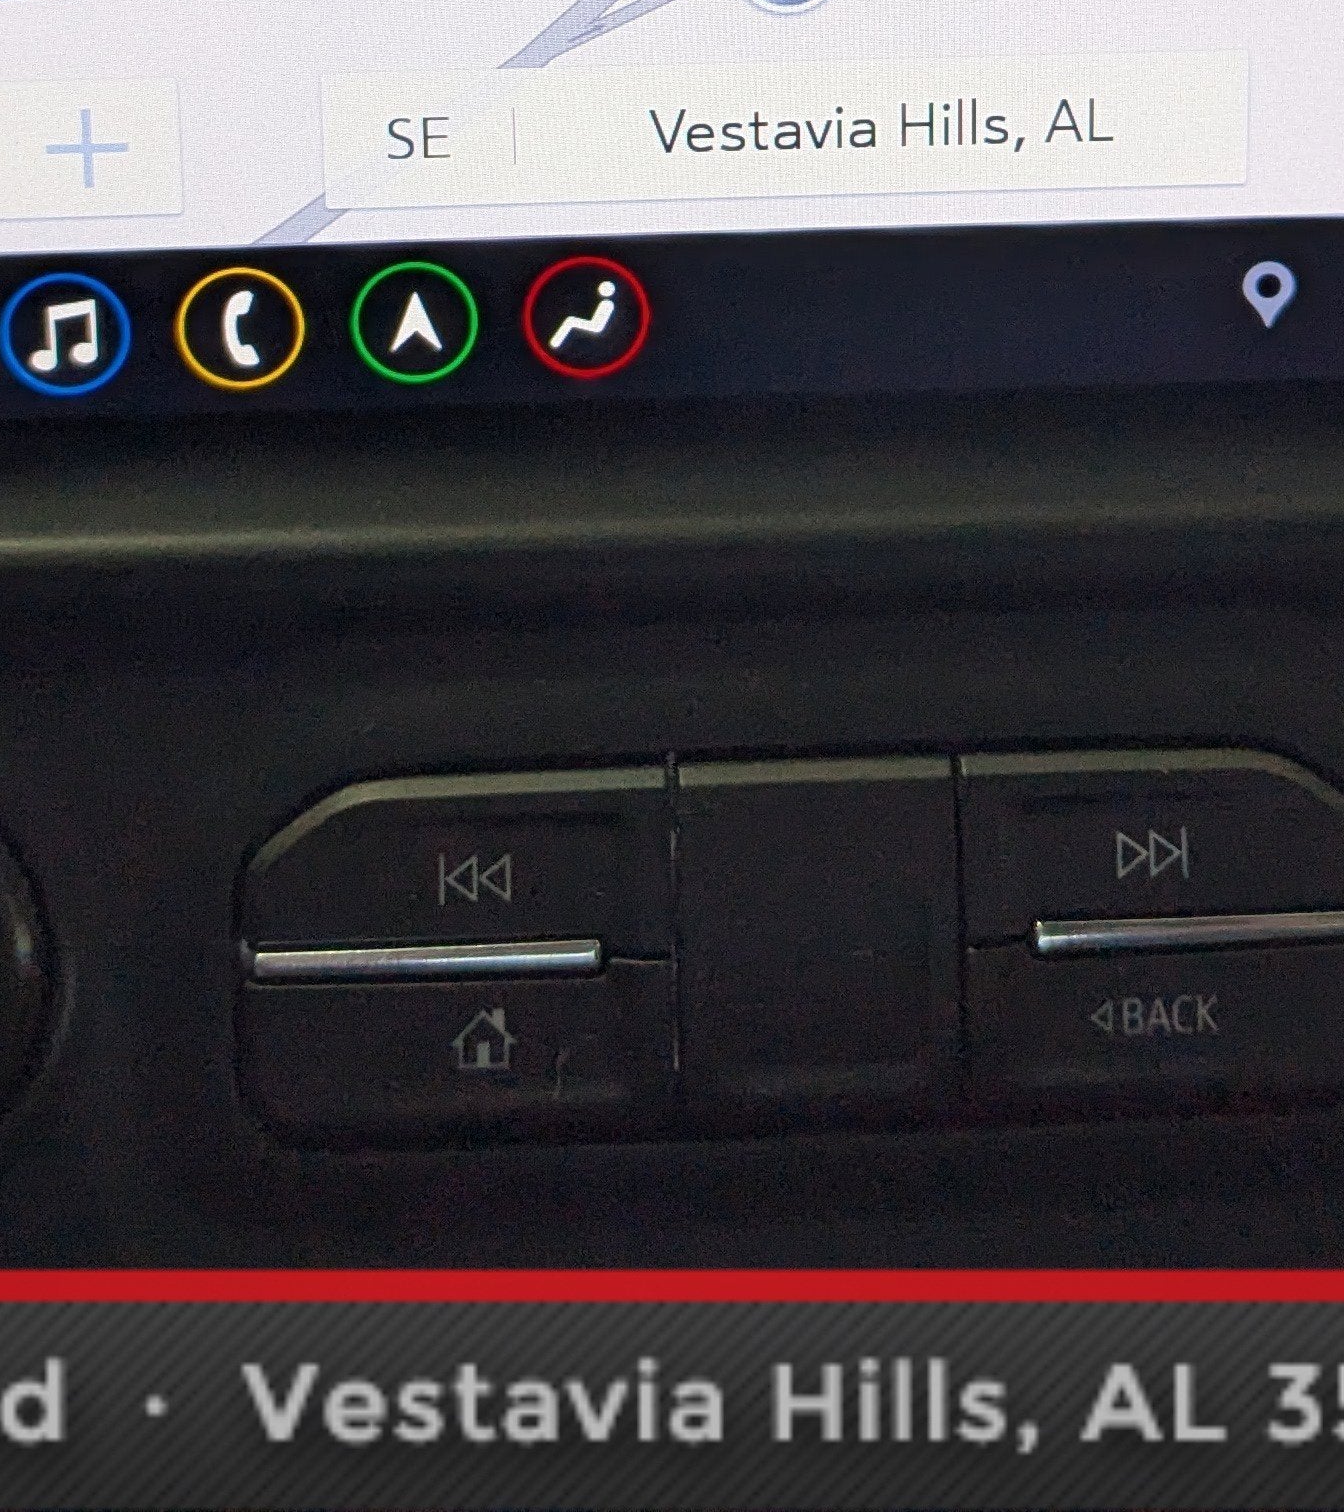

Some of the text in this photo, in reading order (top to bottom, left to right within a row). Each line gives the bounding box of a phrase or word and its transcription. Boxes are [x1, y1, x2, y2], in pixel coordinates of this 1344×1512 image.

[387, 116, 451, 160] SE
[649, 98, 1114, 154] Vestavia Hills, AL
[1122, 993, 1220, 1035] BACK
